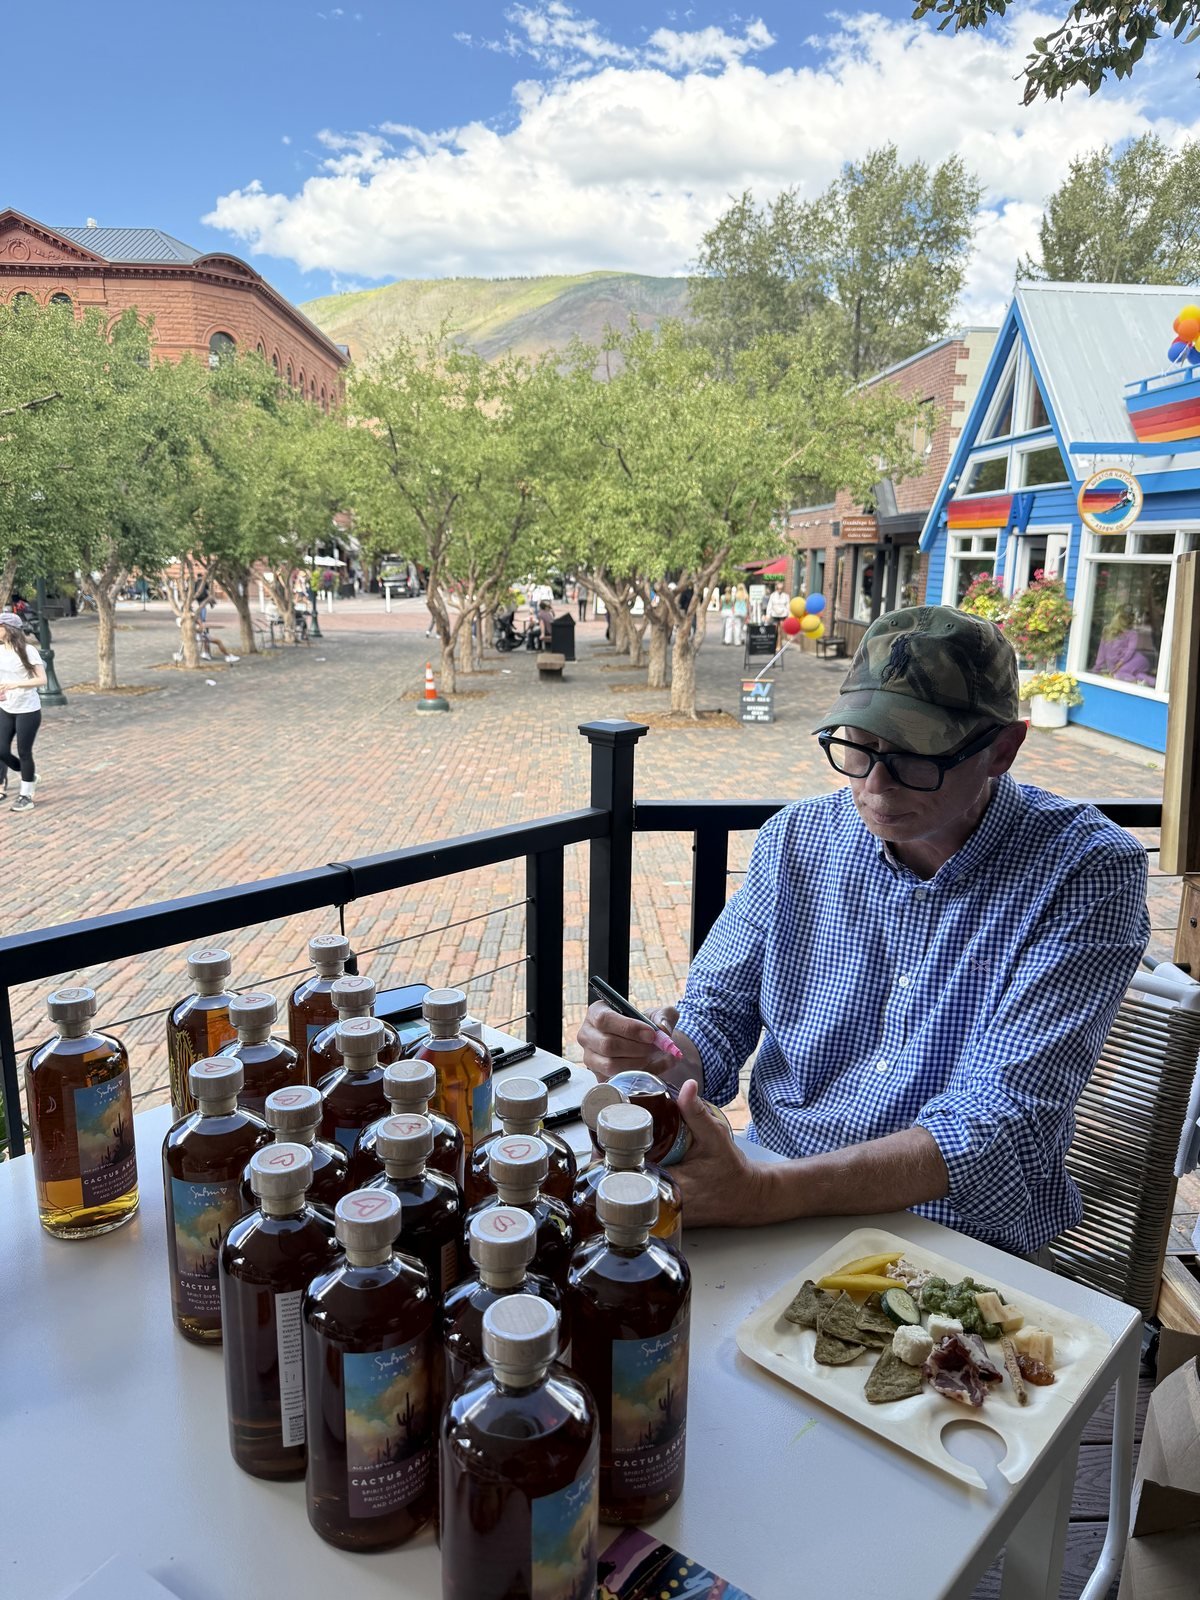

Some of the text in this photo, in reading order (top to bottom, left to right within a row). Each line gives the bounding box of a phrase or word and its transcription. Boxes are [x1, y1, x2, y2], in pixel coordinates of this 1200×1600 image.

[84, 1170, 119, 1185] CACTUS
[181, 1281, 217, 1291] CACTUS
[614, 1453, 661, 1468] CACTUS
[352, 1470, 402, 1486] CACTUS
